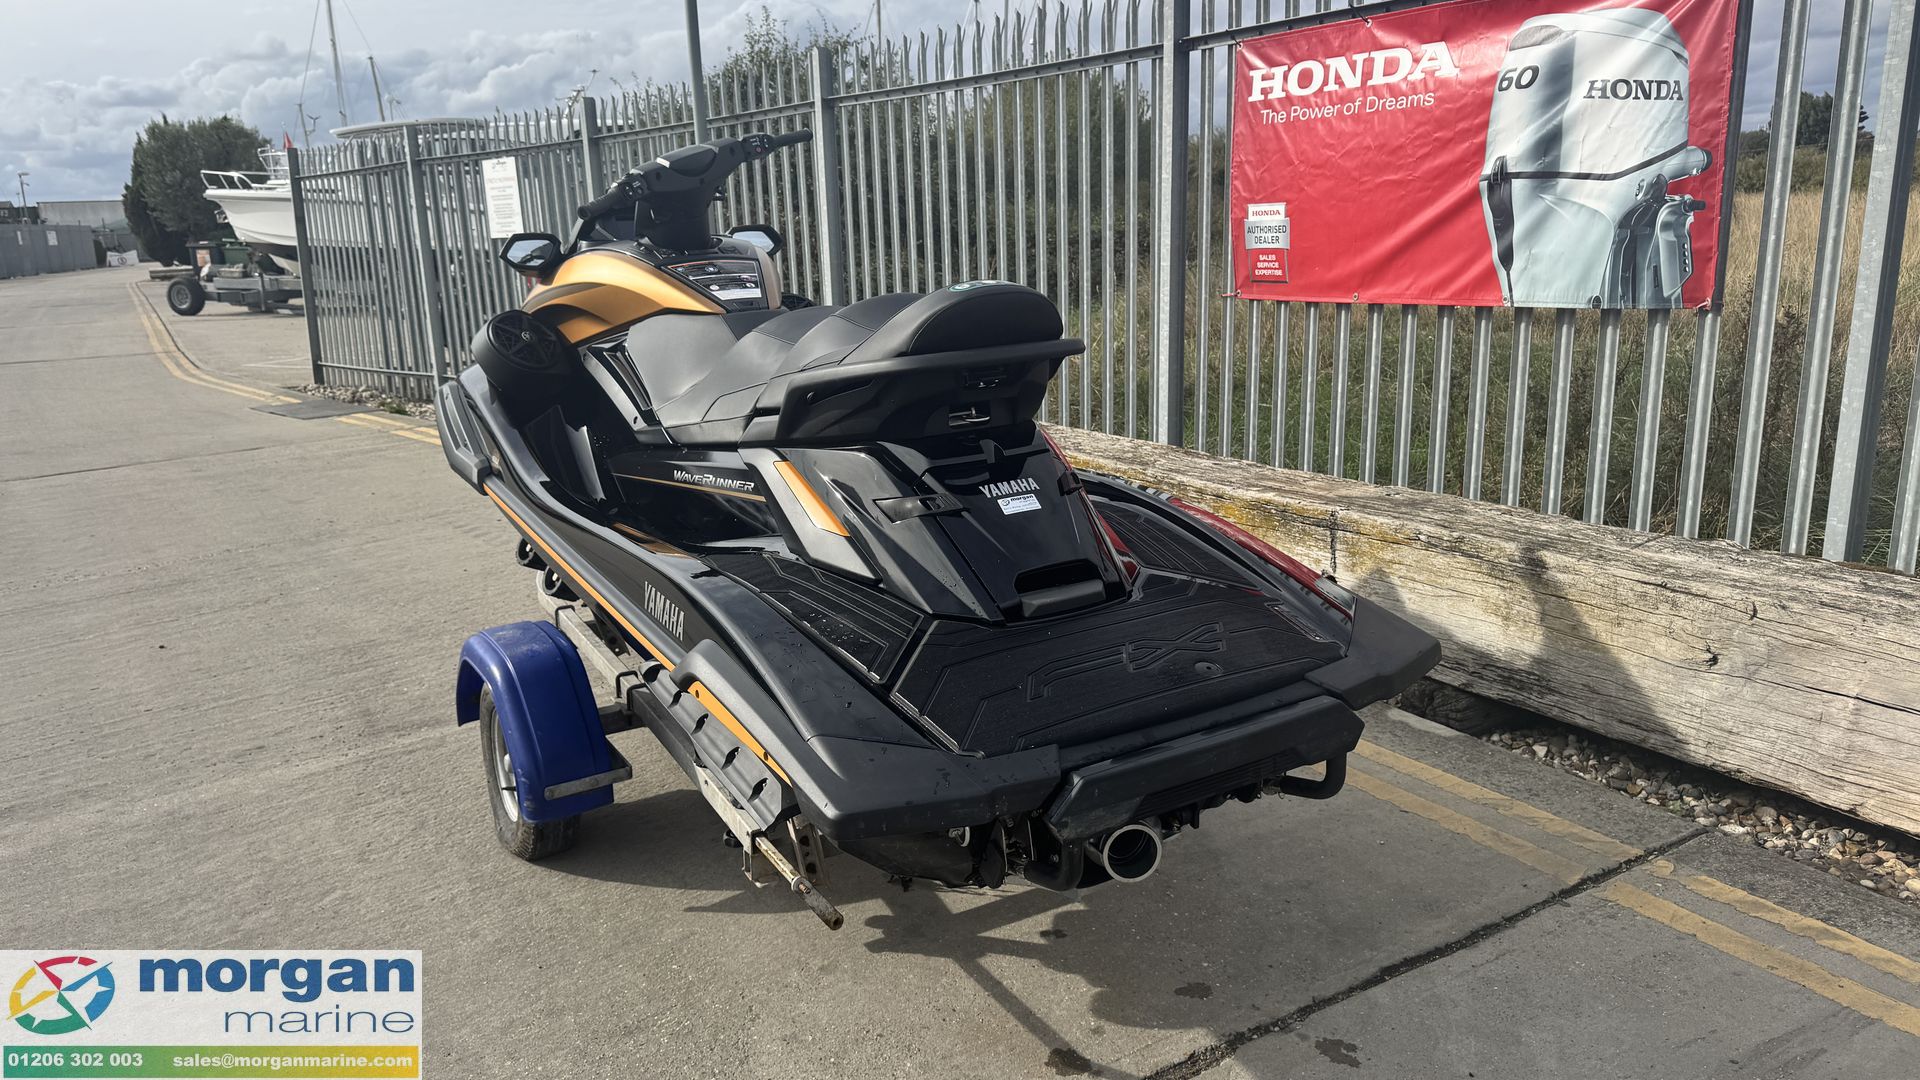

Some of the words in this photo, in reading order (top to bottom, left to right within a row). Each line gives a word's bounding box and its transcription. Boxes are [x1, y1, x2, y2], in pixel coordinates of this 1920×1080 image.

[1247, 41, 1462, 103] HONDA
[1497, 65, 1540, 92] 60
[1583, 79, 1684, 101] HONDA
[1261, 109, 1287, 125] The
[1290, 104, 1341, 122] Power
[1343, 100, 1361, 115] of
[1365, 92, 1435, 113] Dreams
[1252, 209, 1281, 217] HONDA
[1247, 225, 1287, 234] AUTHORISED
[1254, 236, 1280, 244] DEALER
[979, 477, 1041, 498] YAMAHA
[644, 580, 685, 642] YAMAHA
